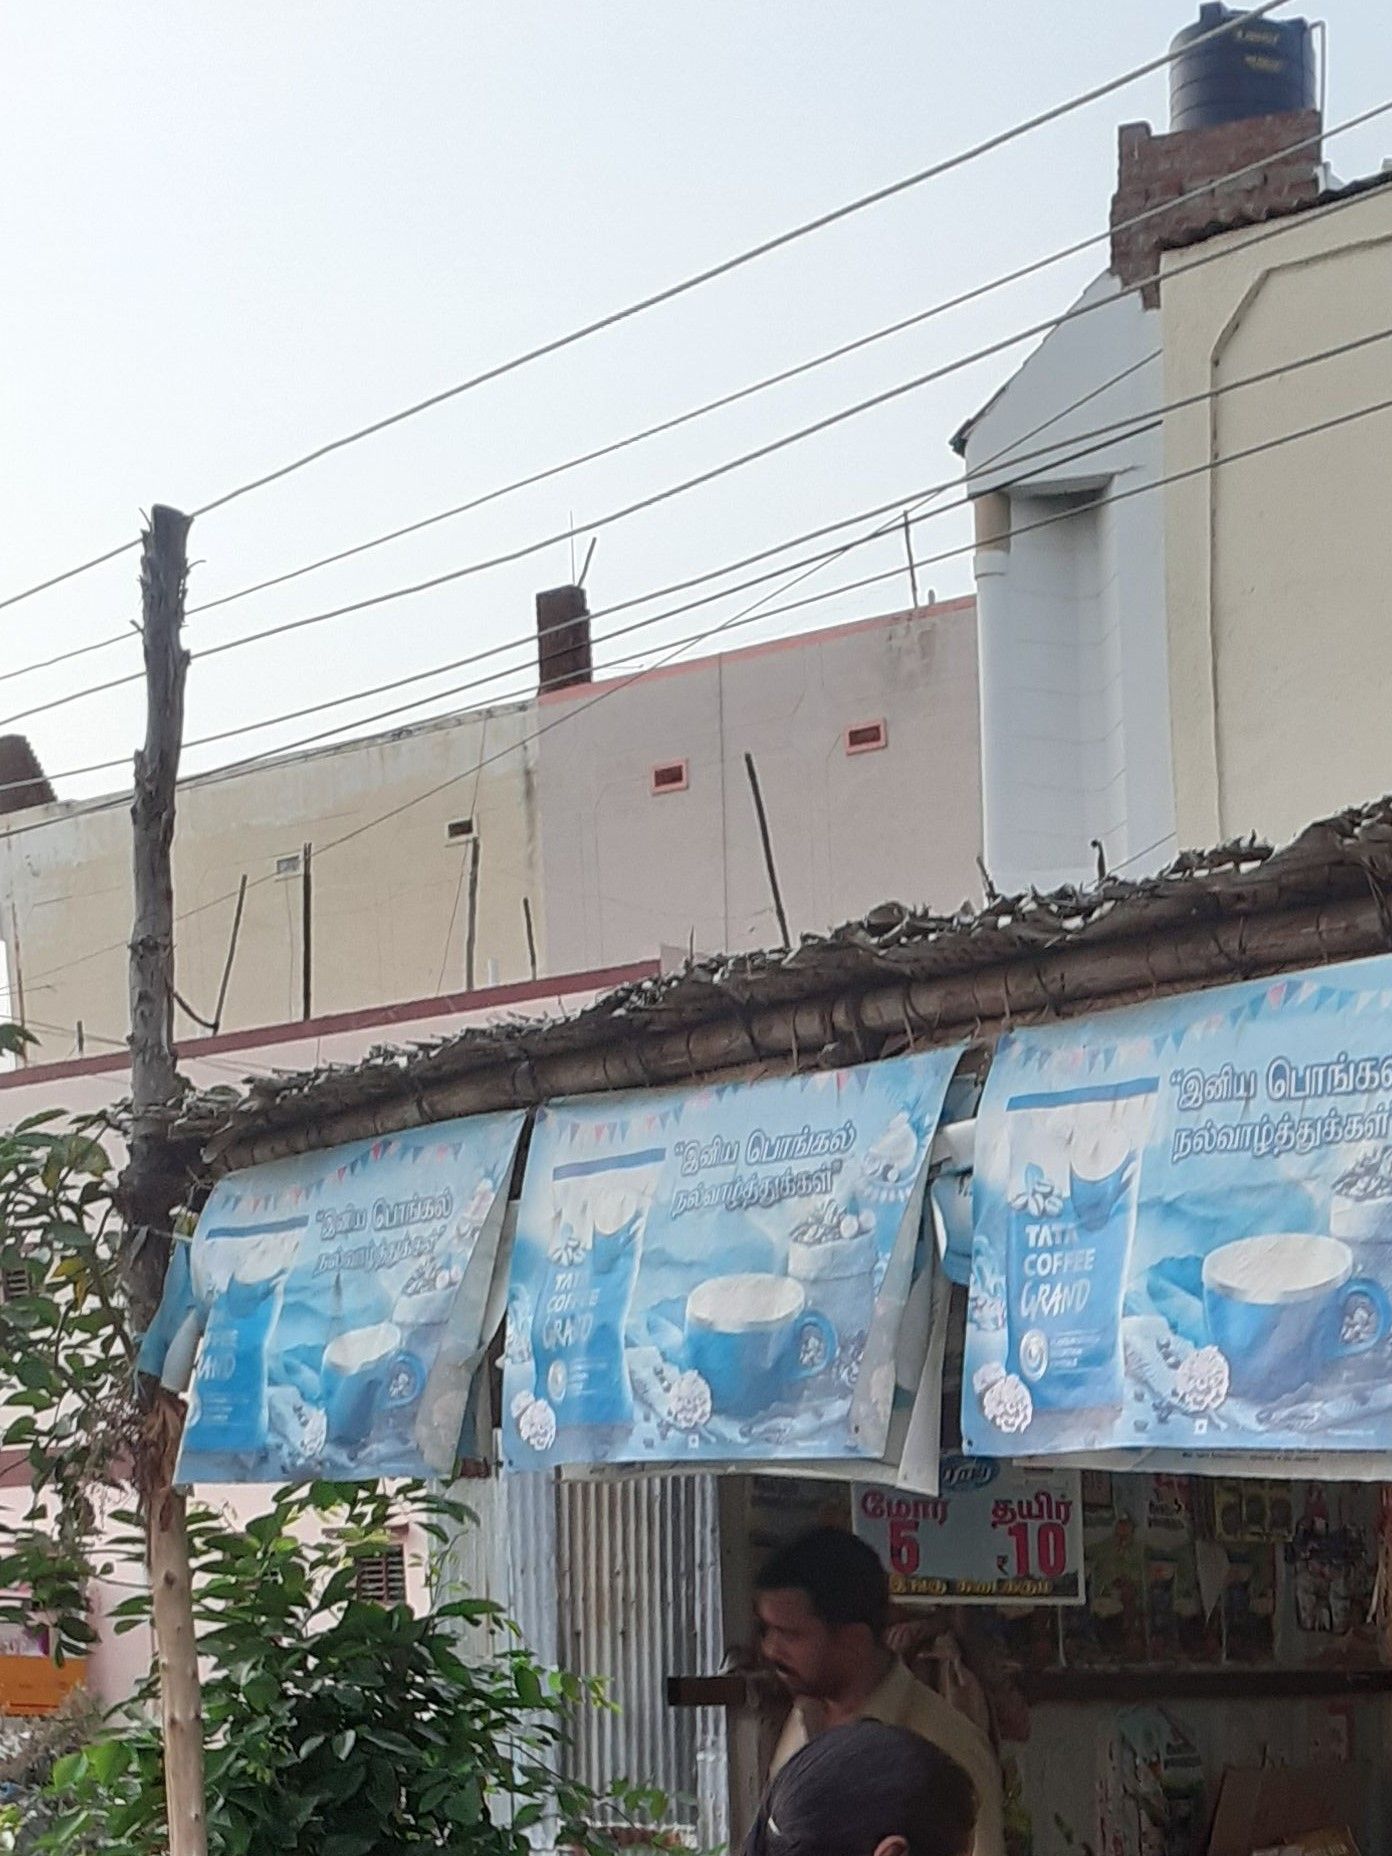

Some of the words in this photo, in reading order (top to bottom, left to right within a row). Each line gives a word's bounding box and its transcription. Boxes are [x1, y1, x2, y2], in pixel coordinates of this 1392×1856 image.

[1025, 1222, 1080, 1249] TATA
[1023, 1248, 1106, 1277] COFFEE
[1021, 1280, 1101, 1321] GRAND
[992, 1488, 1072, 1527] தயிர்
